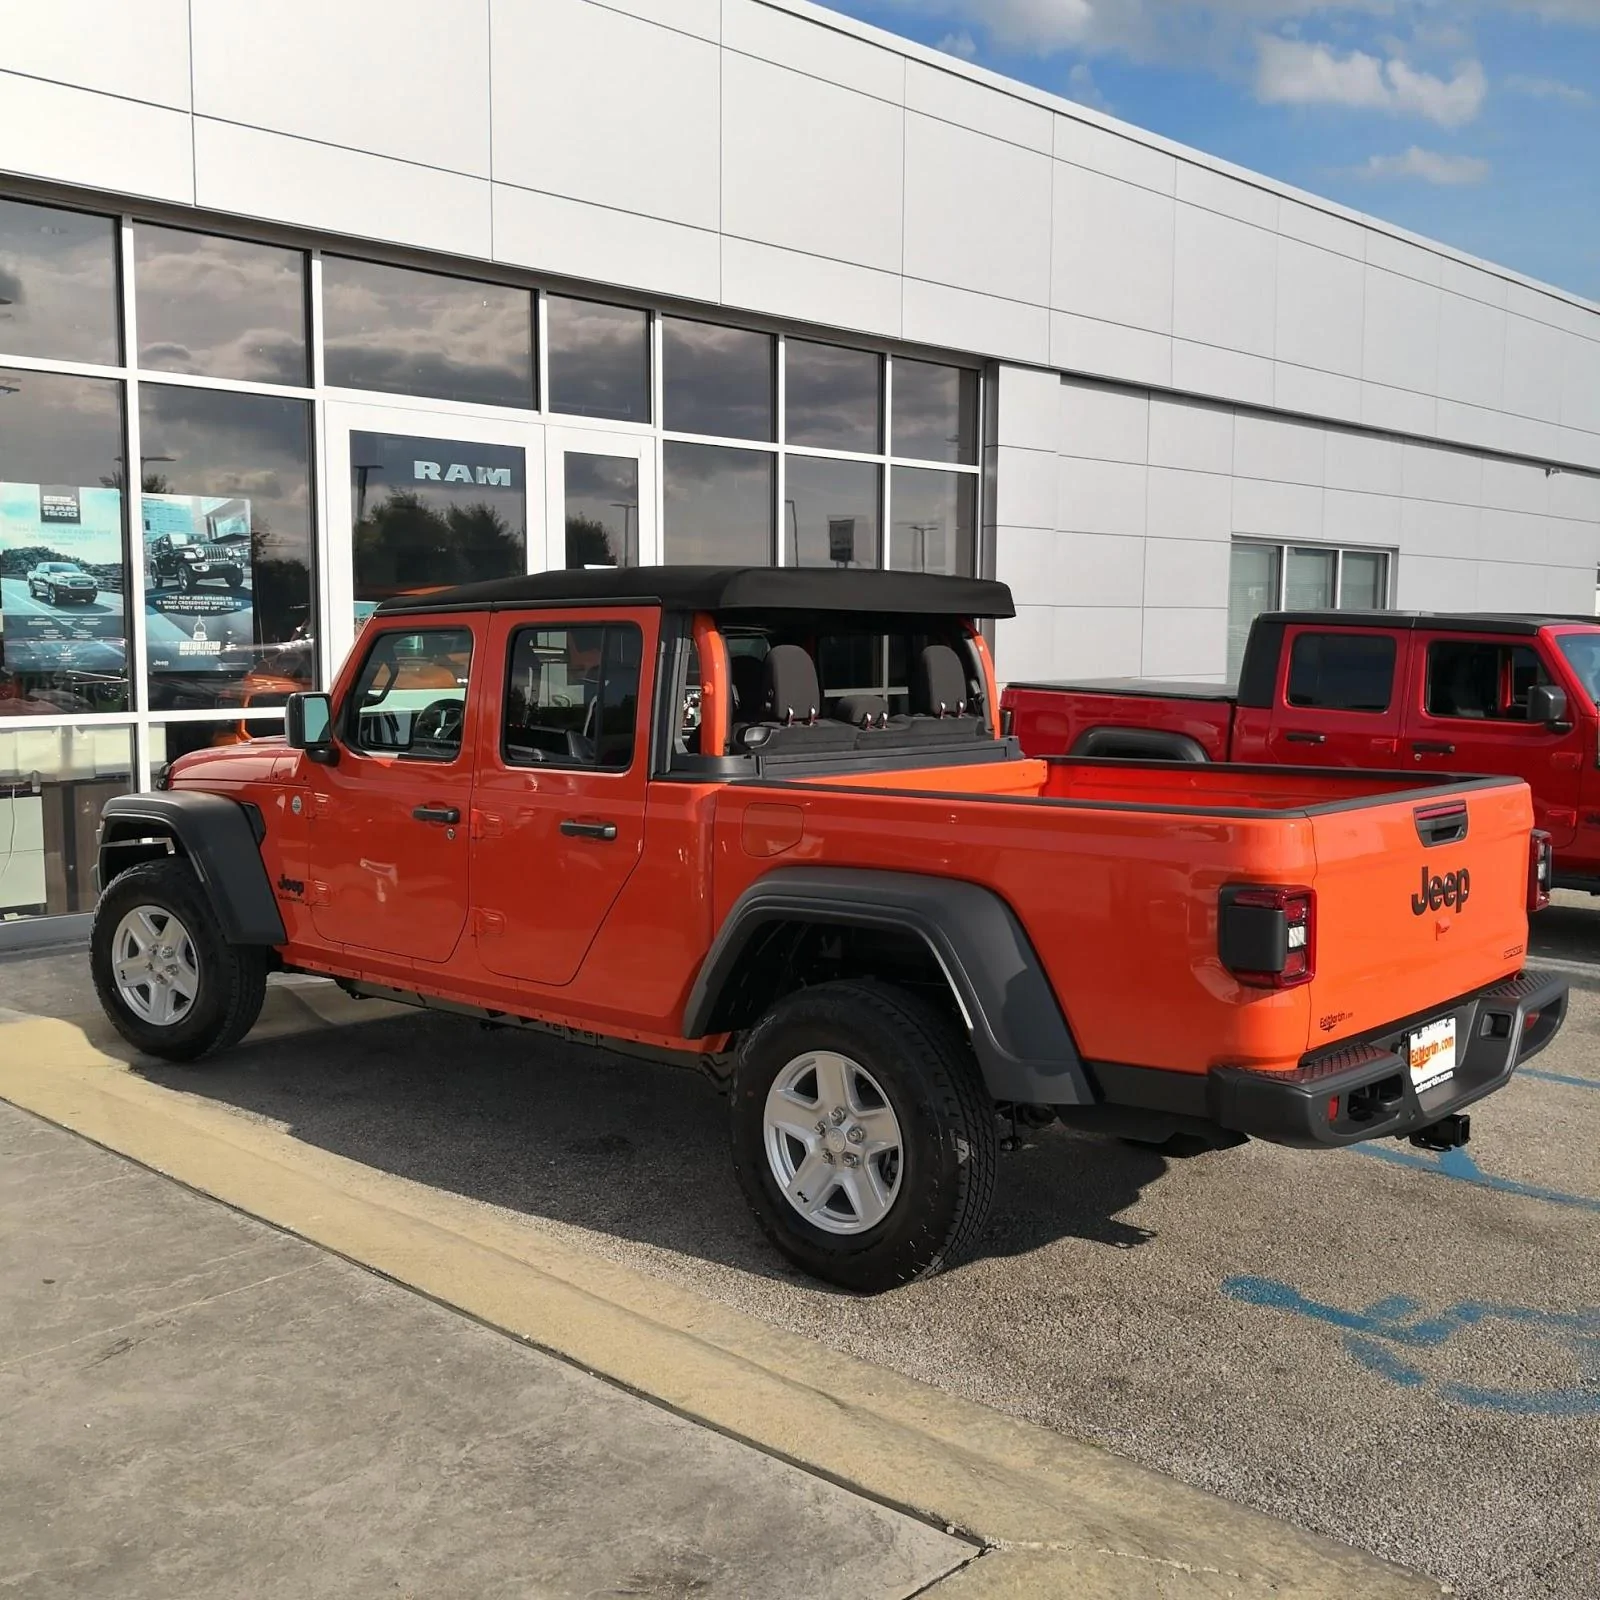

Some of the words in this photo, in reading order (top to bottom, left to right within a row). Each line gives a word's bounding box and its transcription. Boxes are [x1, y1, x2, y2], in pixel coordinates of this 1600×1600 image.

[414, 460, 511, 487] RAM
[277, 873, 304, 897] Jeep
[1411, 865, 1470, 916] Jeep
